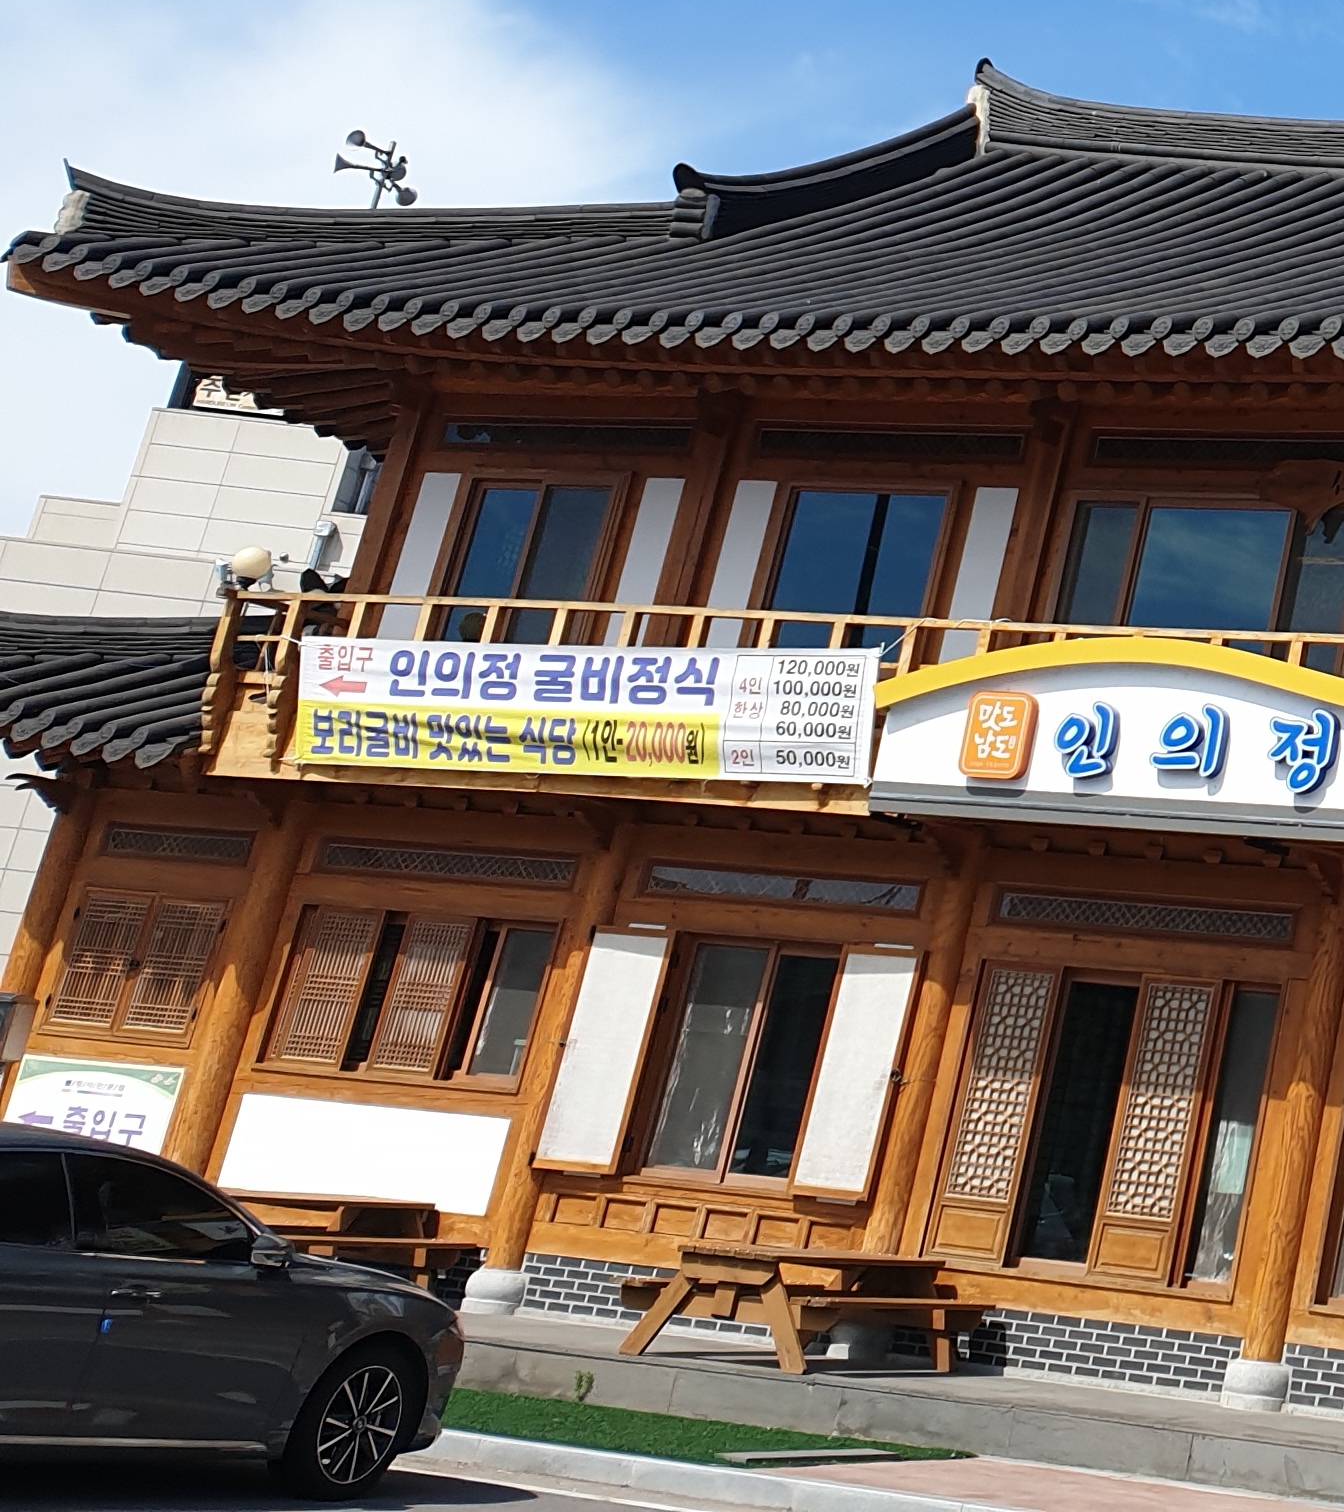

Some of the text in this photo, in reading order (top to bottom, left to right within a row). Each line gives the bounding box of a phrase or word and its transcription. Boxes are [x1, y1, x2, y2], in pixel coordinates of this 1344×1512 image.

[317, 643, 374, 673] 출입구
[389, 649, 720, 707] 인의정 굴비정식
[777, 659, 860, 678] 120,000원
[738, 677, 763, 695] 4인
[773, 679, 857, 699] 100,000원
[733, 701, 764, 719] 한상
[779, 700, 855, 719] 80,000원
[978, 700, 1018, 731] 맛도
[310, 708, 419, 760] 보리굴비
[426, 713, 513, 763] 맛있는
[518, 716, 578, 765] 식당
[775, 721, 852, 740] 60,000원
[974, 729, 1011, 759] 남도
[731, 749, 755, 767] 2인
[775, 749, 850, 770] 50,000원
[63, 1106, 146, 1146] 출입구
